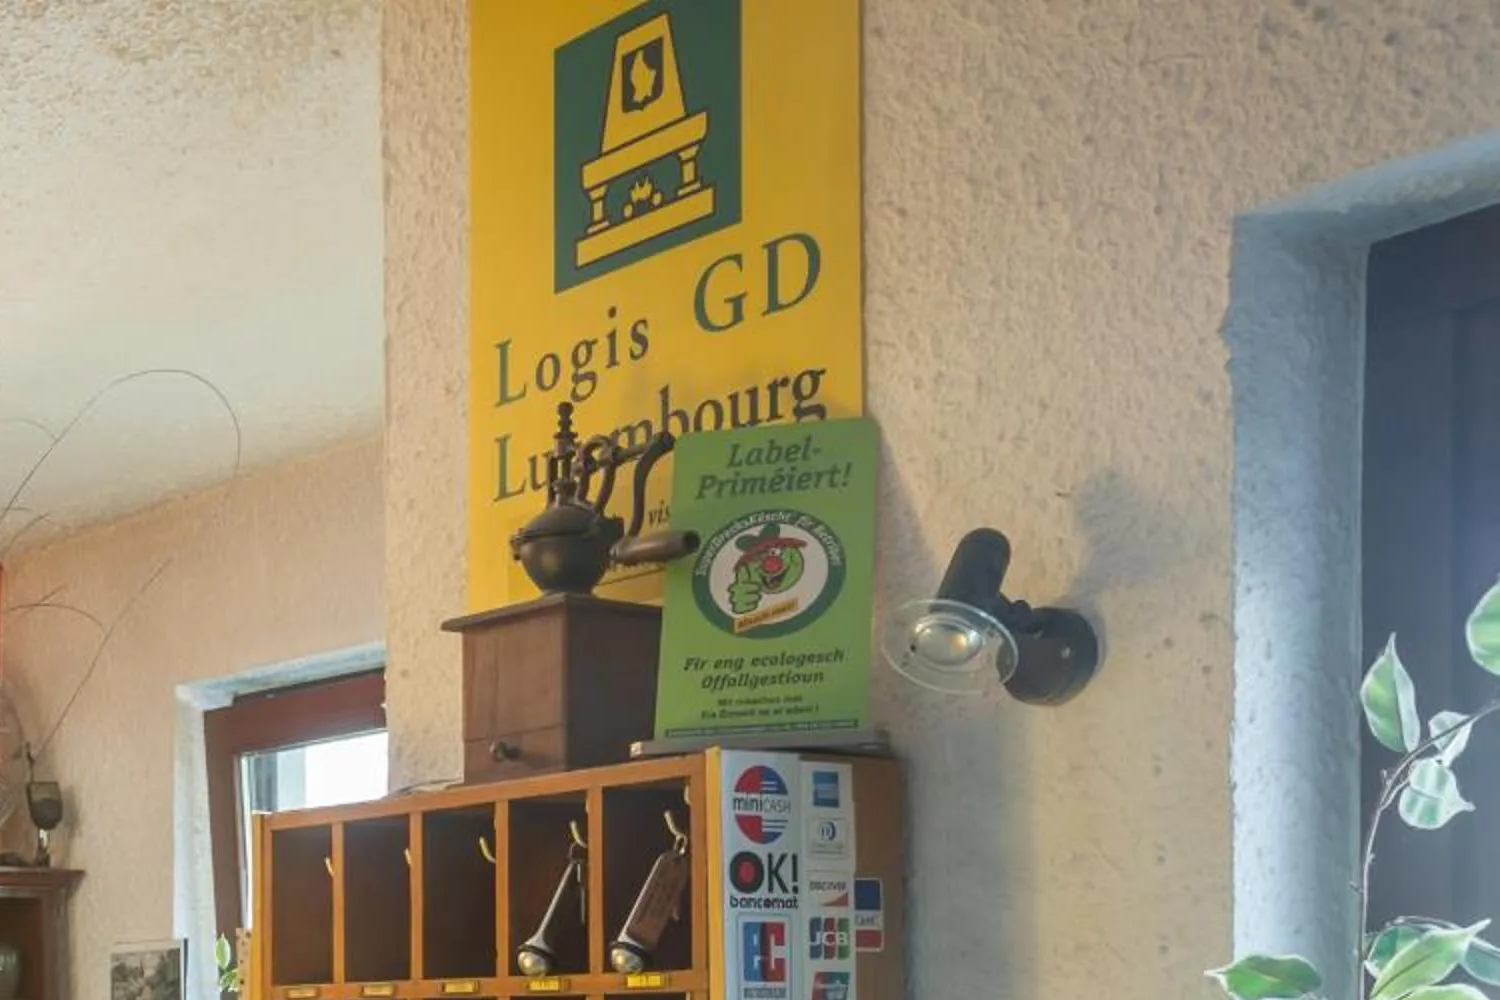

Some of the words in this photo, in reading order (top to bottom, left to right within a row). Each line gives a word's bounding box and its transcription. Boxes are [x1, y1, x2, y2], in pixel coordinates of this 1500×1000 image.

[494, 306, 650, 408] Logis
[693, 232, 822, 333] GD
[727, 435, 822, 468] Label-
[696, 462, 853, 500] Priméiert!
[683, 657, 708, 672] Fir
[713, 656, 745, 671] eng
[750, 648, 846, 667] ecologesch
[729, 851, 799, 895] OK!
[809, 931, 848, 946] JCB
